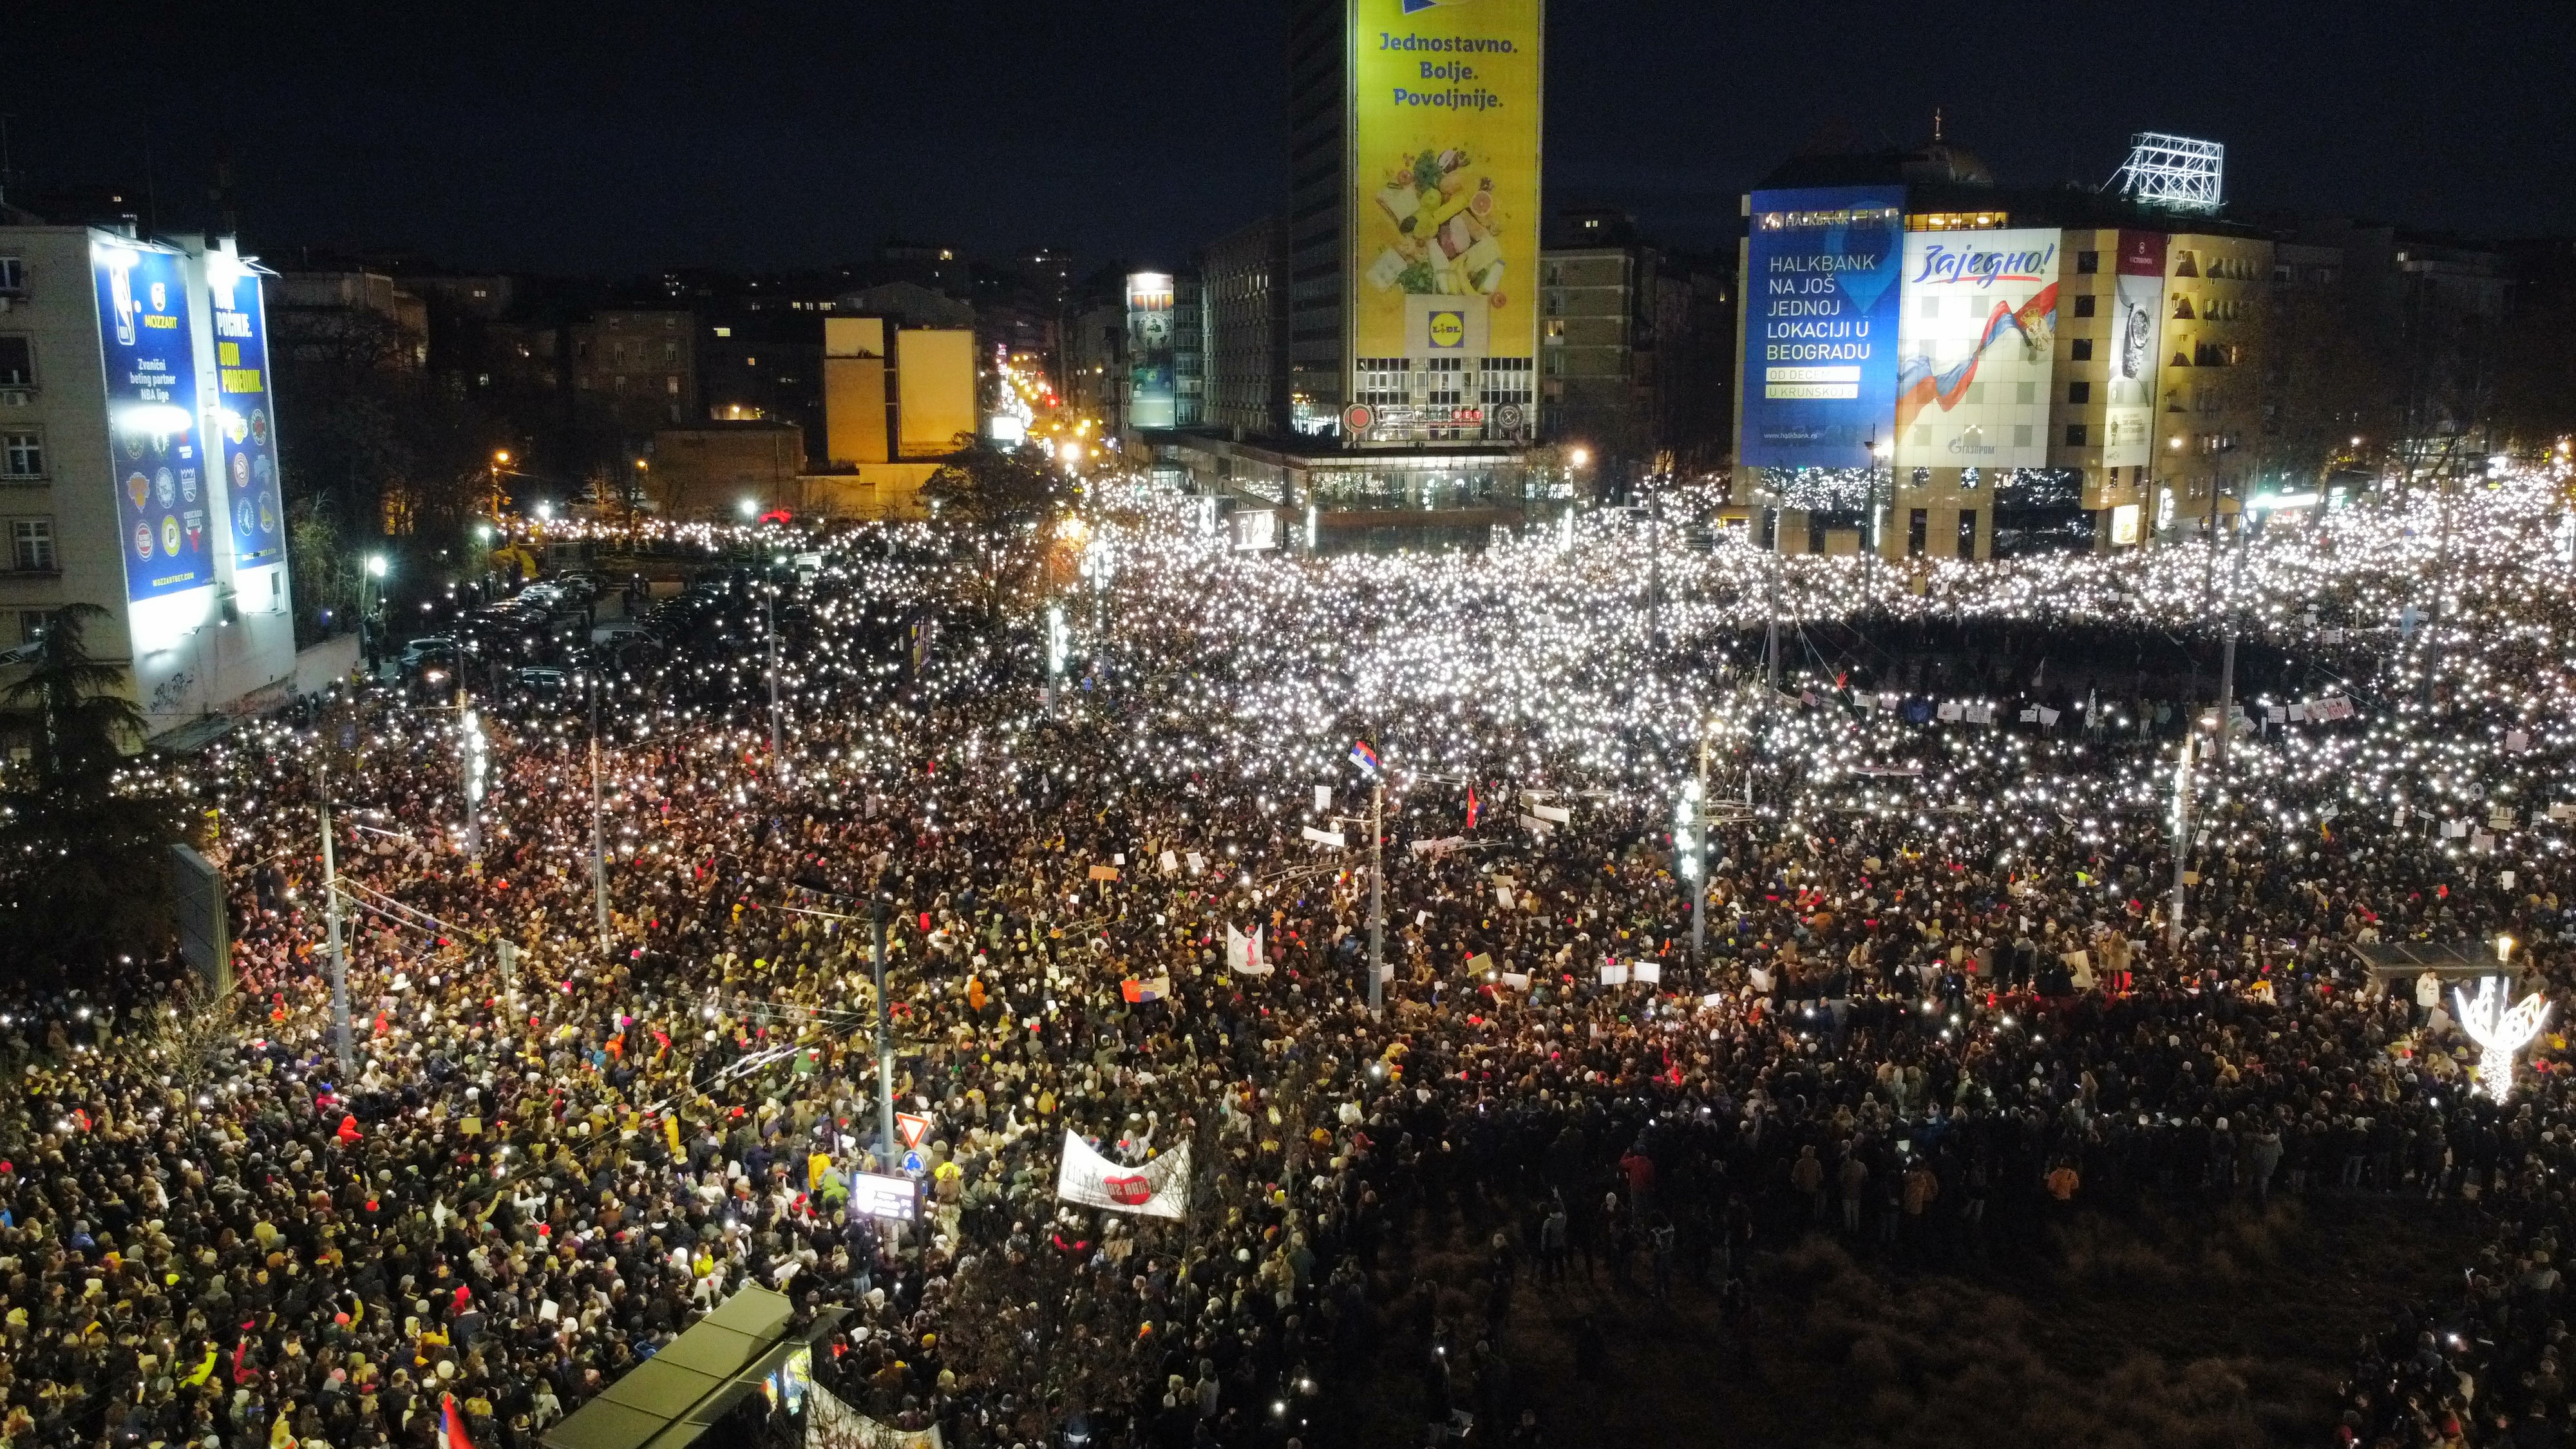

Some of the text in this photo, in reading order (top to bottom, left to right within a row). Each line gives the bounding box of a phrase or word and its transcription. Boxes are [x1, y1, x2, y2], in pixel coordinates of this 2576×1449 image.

[1379, 32, 1518, 54] Jednostavno.
[1419, 61, 1479, 84] Bolje.
[1394, 88, 1504, 111] Povoljnije.
[1770, 254, 1875, 273] HALKBANK
[1911, 243, 2055, 289] Заједно!
[1769, 273, 1835, 295] NA JOŠ
[1767, 299, 1841, 317] JEDNOJ
[145, 315, 177, 328] MOZZART
[1767, 321, 1868, 339] LOKACIJI U
[219, 342, 241, 366] BUDI
[1766, 343, 1871, 361] BEOGRADU
[138, 358, 166, 370] Zvanični
[130, 372, 176, 387] beting partner
[1770, 370, 1830, 380] OD DECEM
[141, 388, 169, 403] NBA lige
[1769, 388, 1777, 397] U
[1781, 387, 1844, 397] KRUNSKOJ
